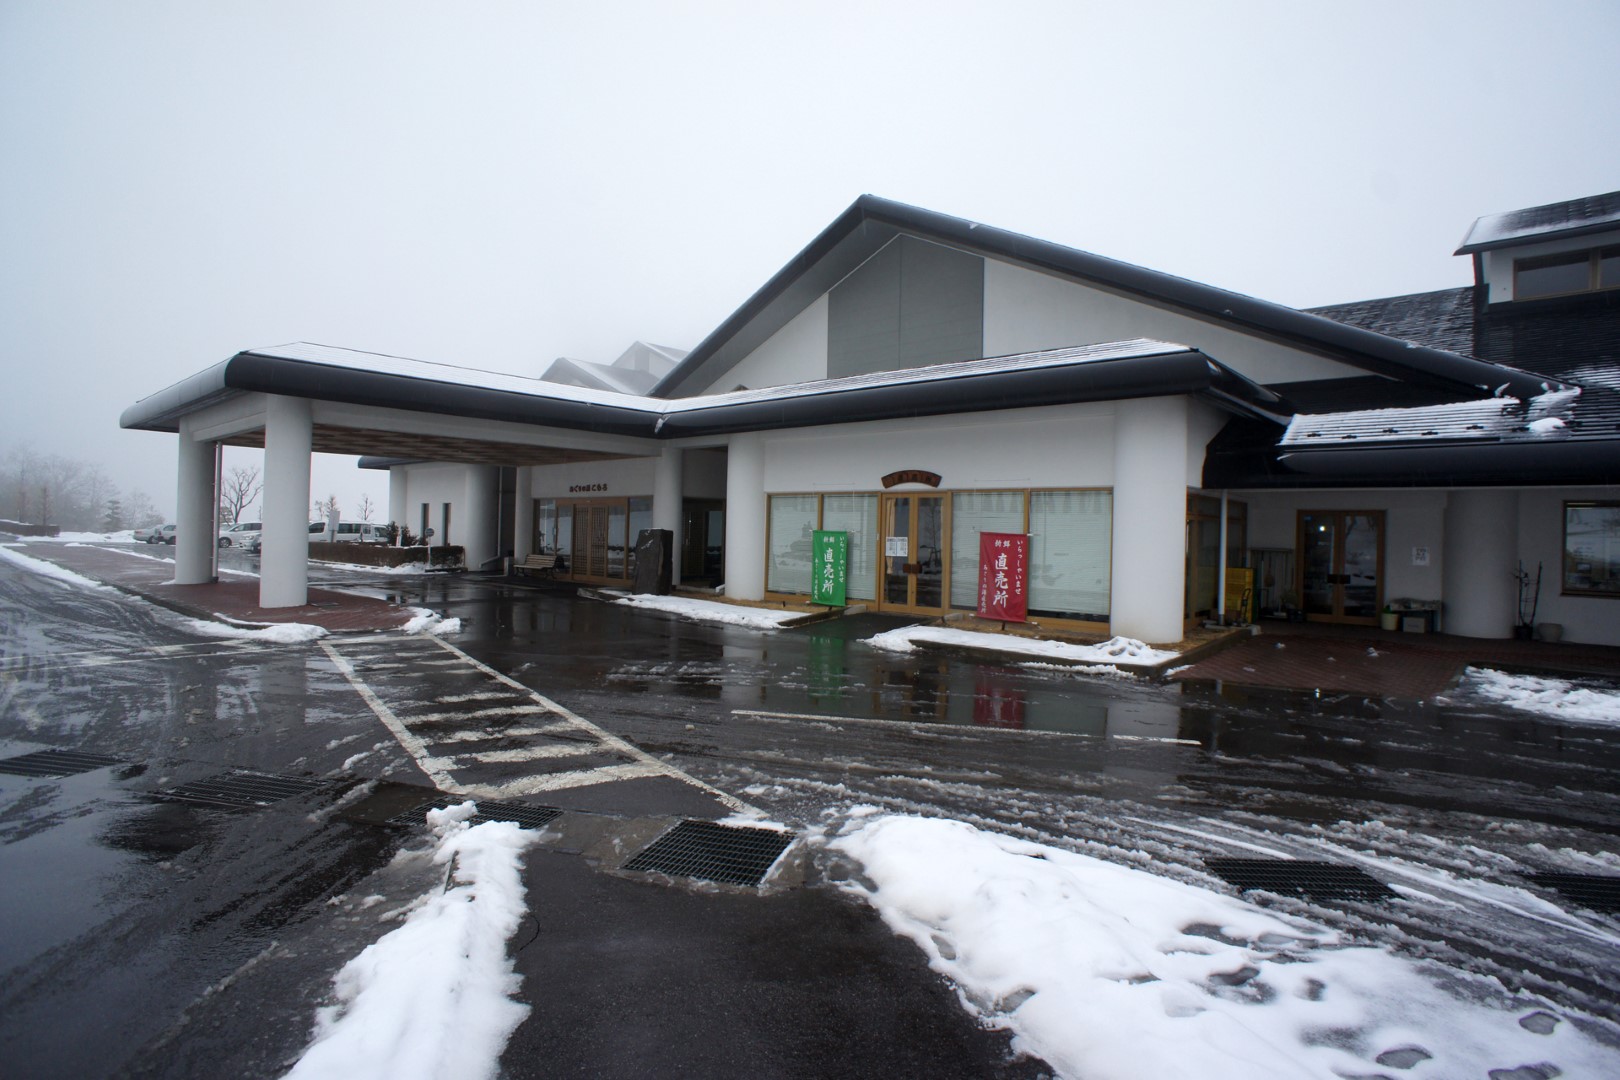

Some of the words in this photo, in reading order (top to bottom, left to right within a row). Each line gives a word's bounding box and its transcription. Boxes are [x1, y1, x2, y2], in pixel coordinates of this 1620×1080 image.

[822, 547, 834, 595] 直売所
[992, 552, 1009, 609] 直売所
[1015, 540, 1023, 595] いらっしゃいませ
